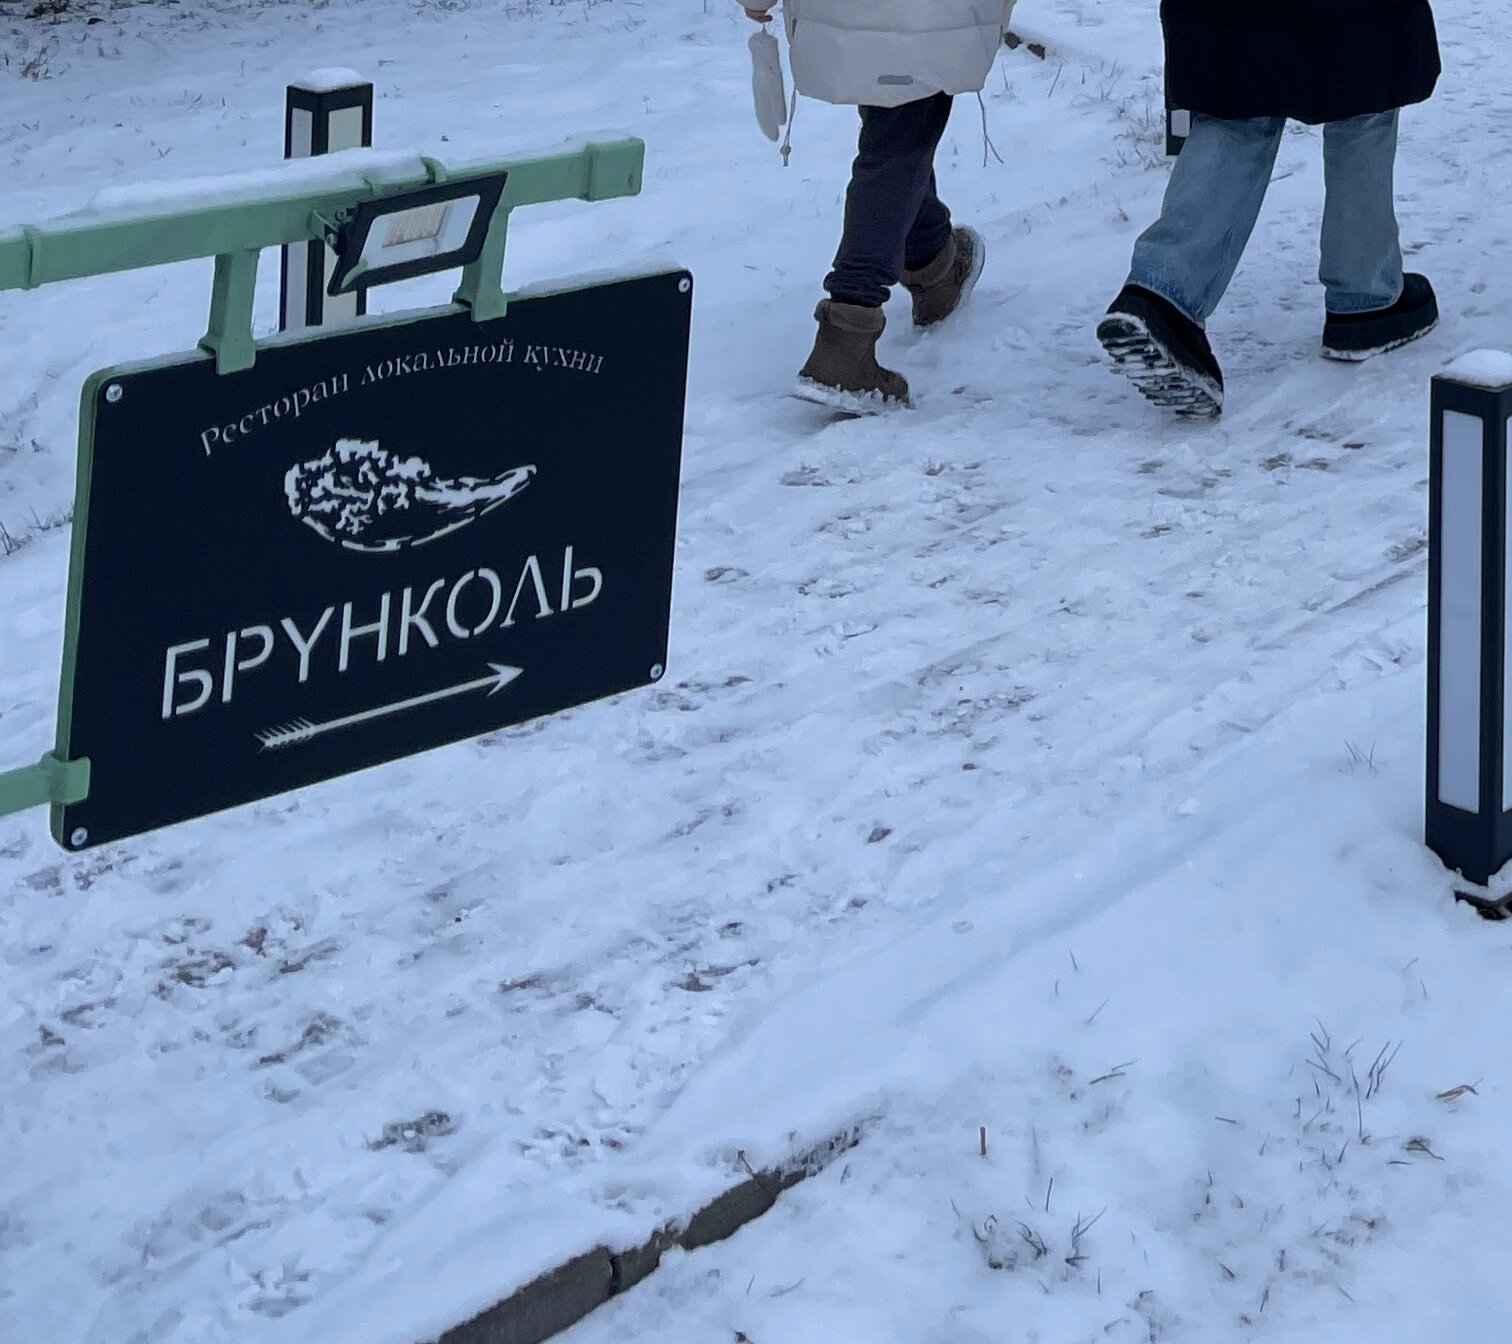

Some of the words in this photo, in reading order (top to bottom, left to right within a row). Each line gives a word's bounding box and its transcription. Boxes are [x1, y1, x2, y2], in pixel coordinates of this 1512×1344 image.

[200, 371, 350, 457] Ресторан
[360, 337, 517, 386] локальной
[522, 343, 606, 375] кухни
[161, 544, 605, 719] БРУНКОЛЬ
